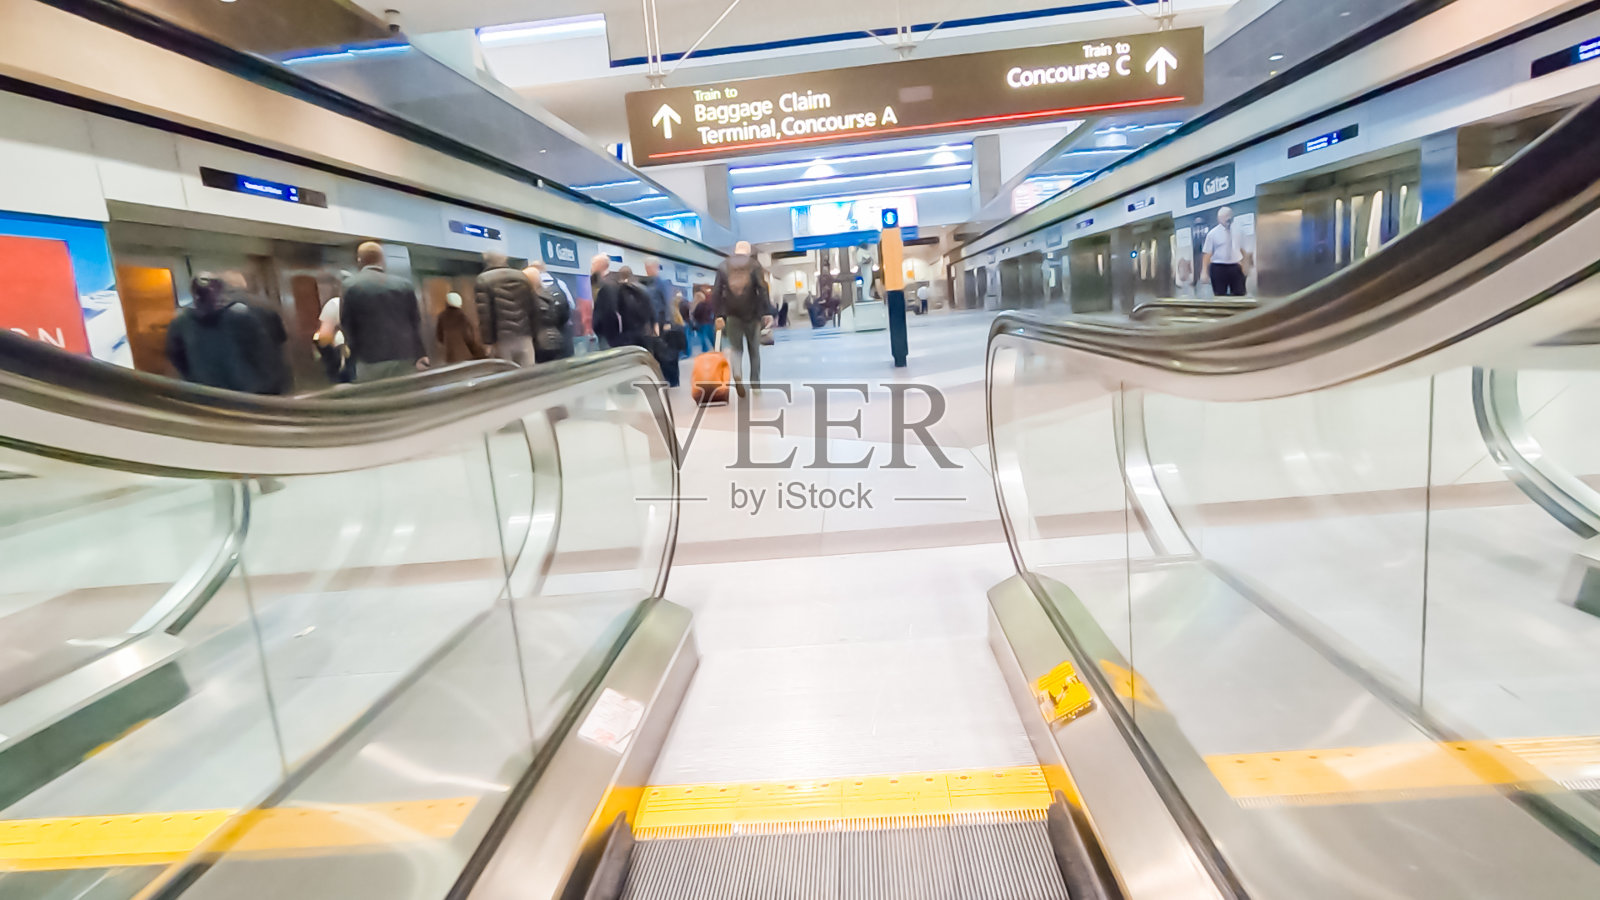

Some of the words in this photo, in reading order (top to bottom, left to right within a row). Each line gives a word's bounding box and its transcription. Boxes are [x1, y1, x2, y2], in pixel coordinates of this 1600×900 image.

[1082, 42, 1112, 58] Train
[1115, 42, 1130, 54] to
[1007, 61, 1110, 88] Concourse
[1115, 55, 1131, 76] C
[693, 89, 721, 101] Train
[724, 87, 738, 99] to
[694, 100, 773, 124] Baggage
[779, 90, 831, 113] Claim
[881, 106, 898, 125] A
[1203, 175, 1230, 195] Gates
